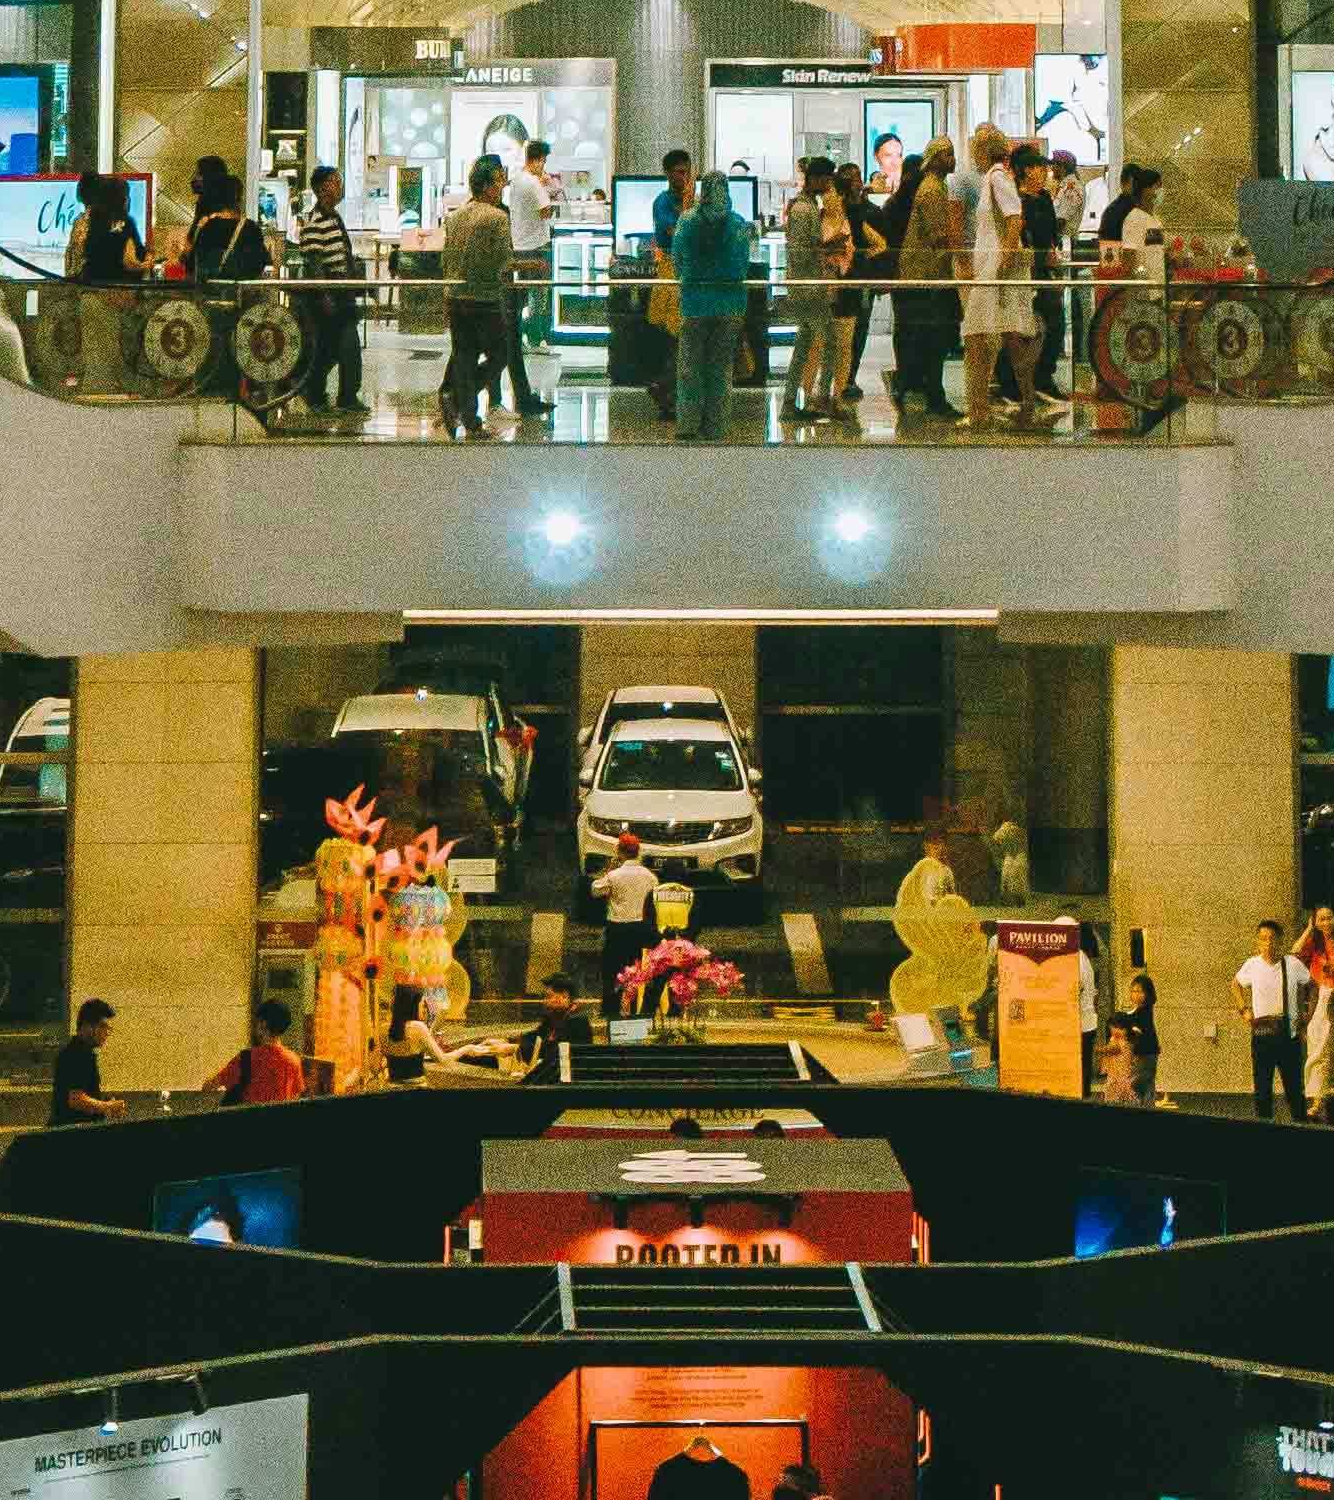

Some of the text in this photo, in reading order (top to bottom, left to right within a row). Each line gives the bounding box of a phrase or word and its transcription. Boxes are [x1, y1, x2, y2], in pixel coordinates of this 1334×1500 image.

[782, 69, 815, 85] Skin
[1008, 931, 1068, 944] PAVILION
[34, 1427, 223, 1475] MASTERPIECE EVOLUTION
